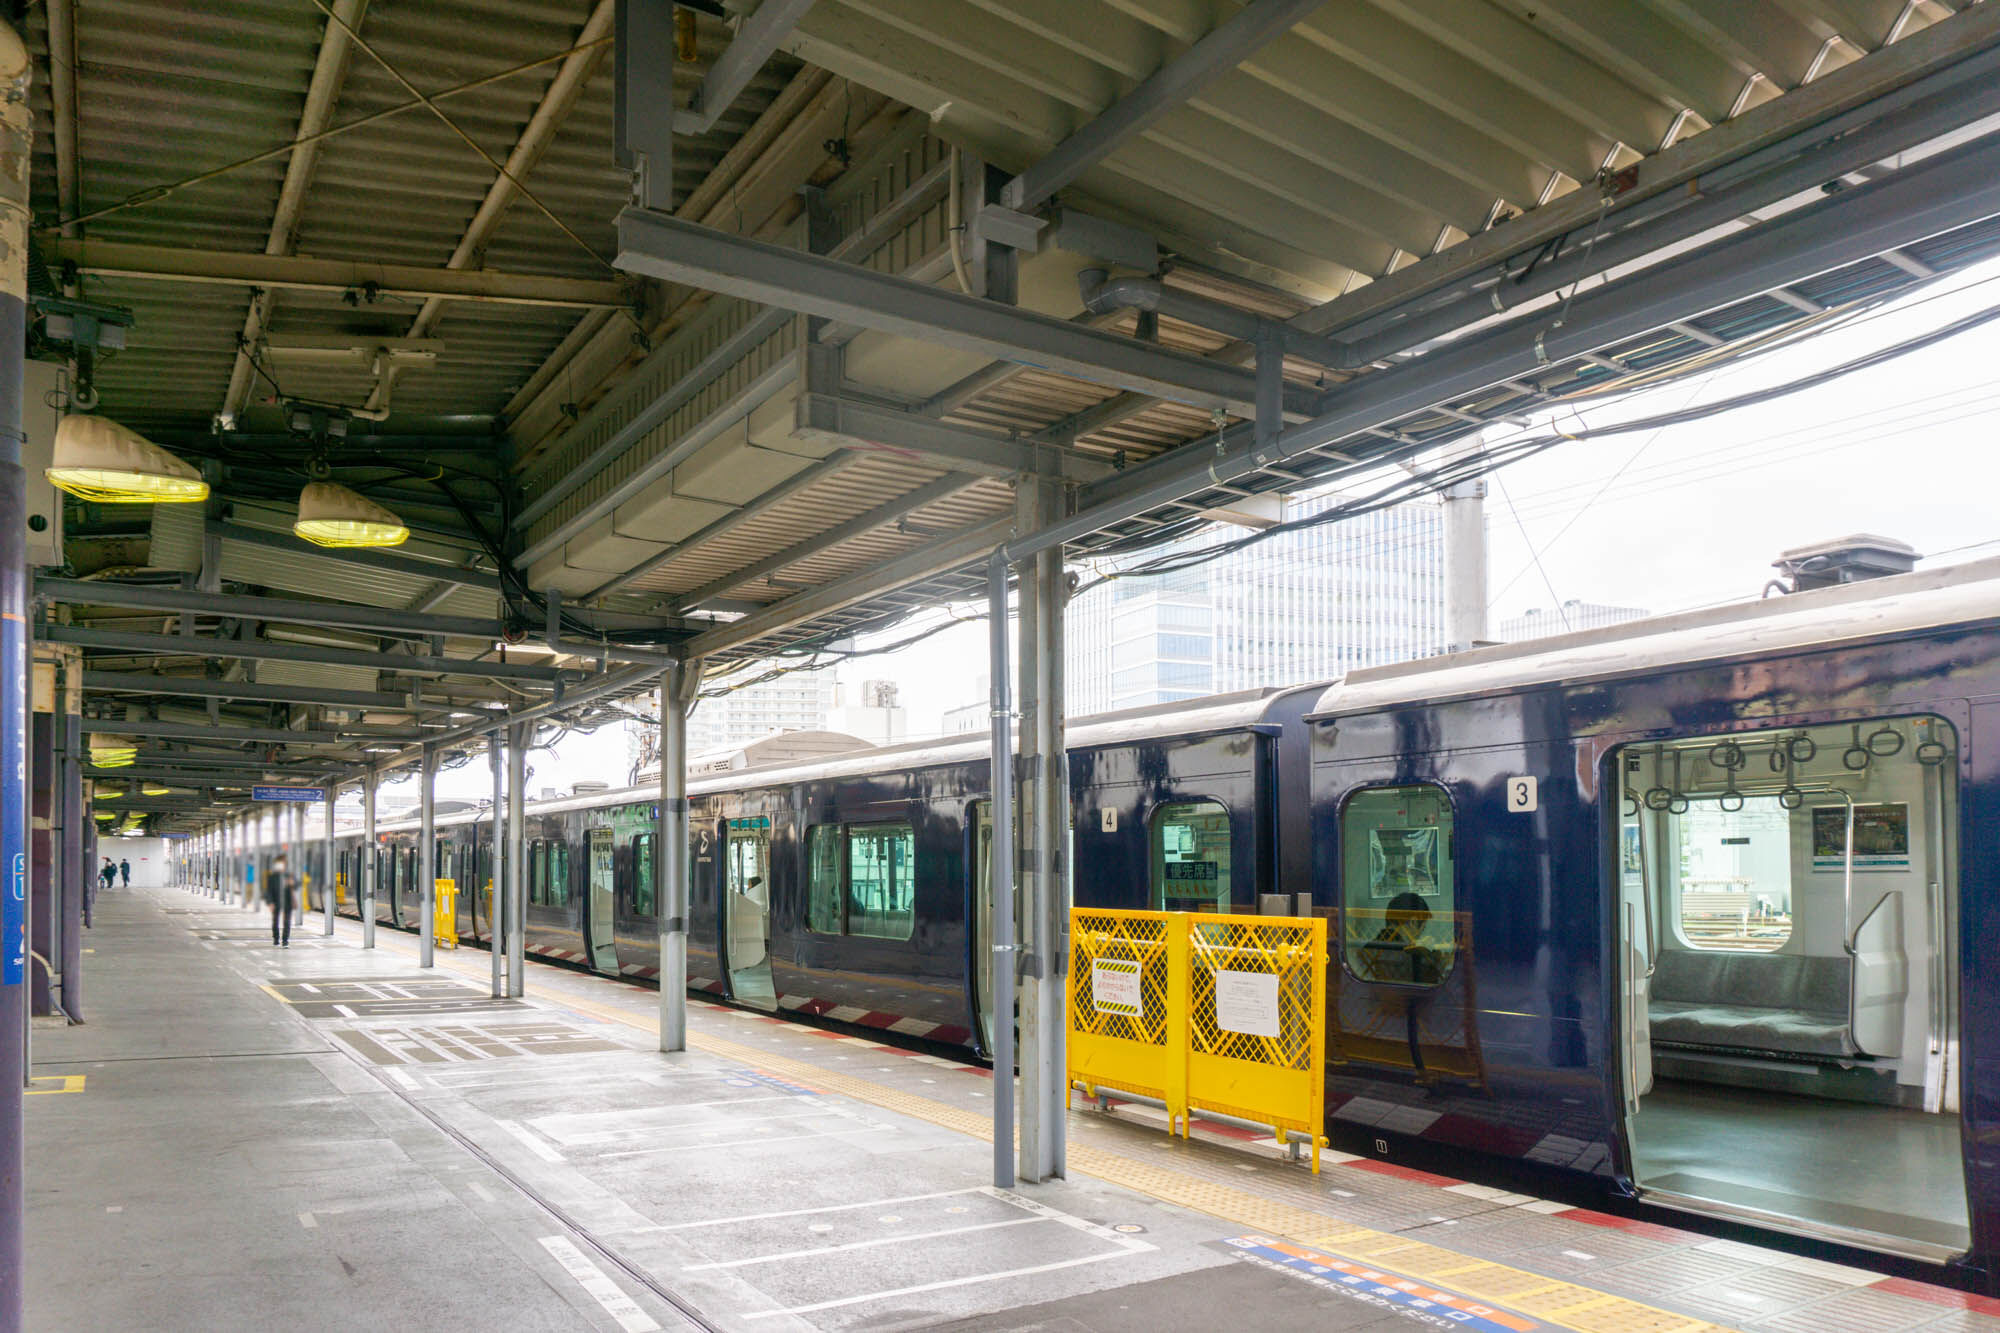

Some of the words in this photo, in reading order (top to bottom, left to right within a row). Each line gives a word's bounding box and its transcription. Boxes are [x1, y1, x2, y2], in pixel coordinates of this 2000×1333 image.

[316, 790, 324, 800] 2
[1516, 782, 1528, 806] 3
[1106, 811, 1113, 828] 4
